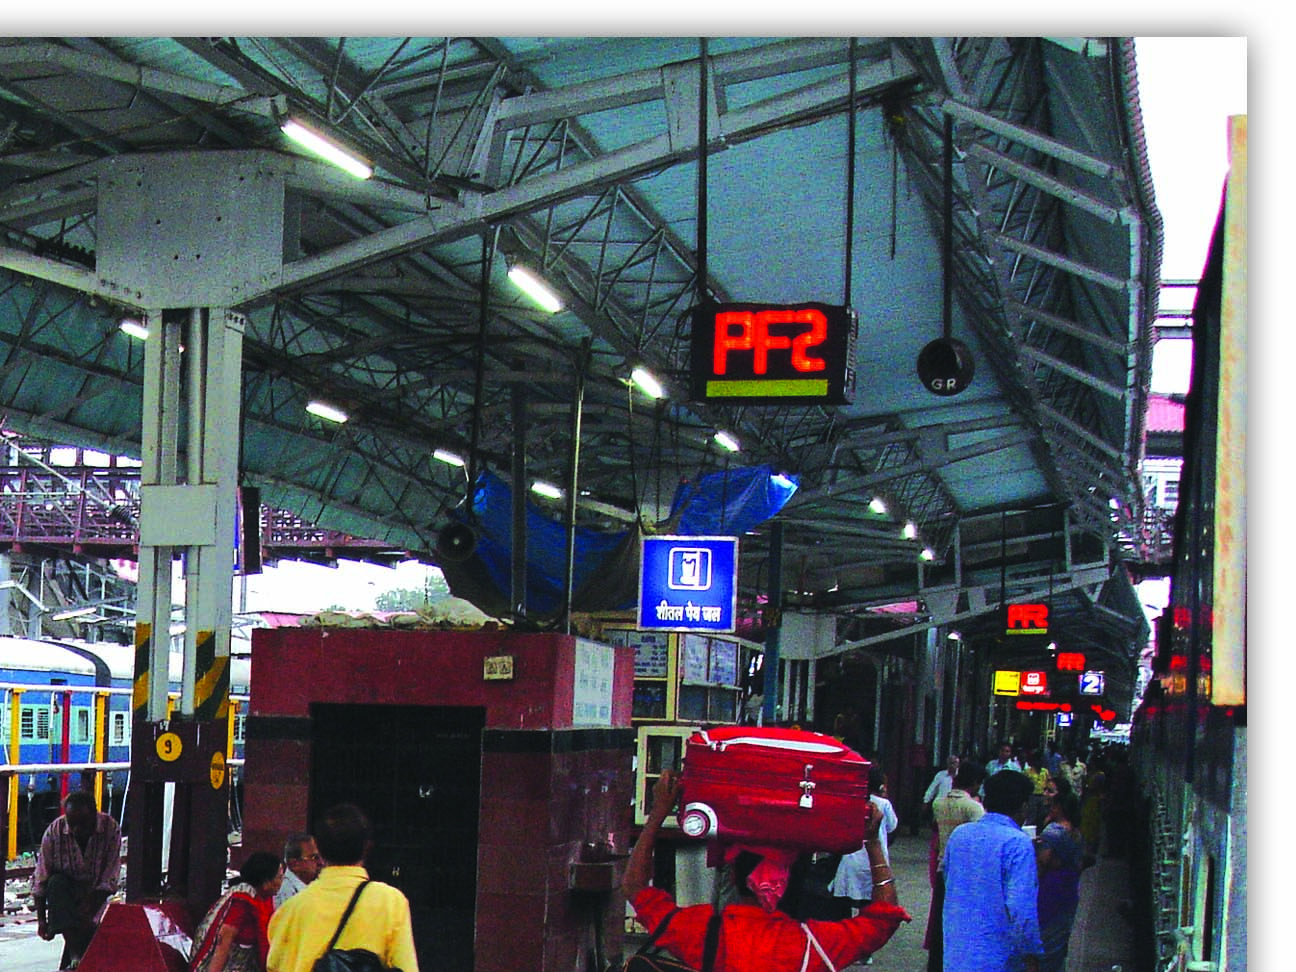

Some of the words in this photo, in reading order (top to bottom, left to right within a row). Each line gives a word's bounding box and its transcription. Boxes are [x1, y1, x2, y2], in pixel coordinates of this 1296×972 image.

[713, 309, 828, 375] PF2
[1082, 675, 1100, 693] 2
[164, 739, 172, 754] 9
